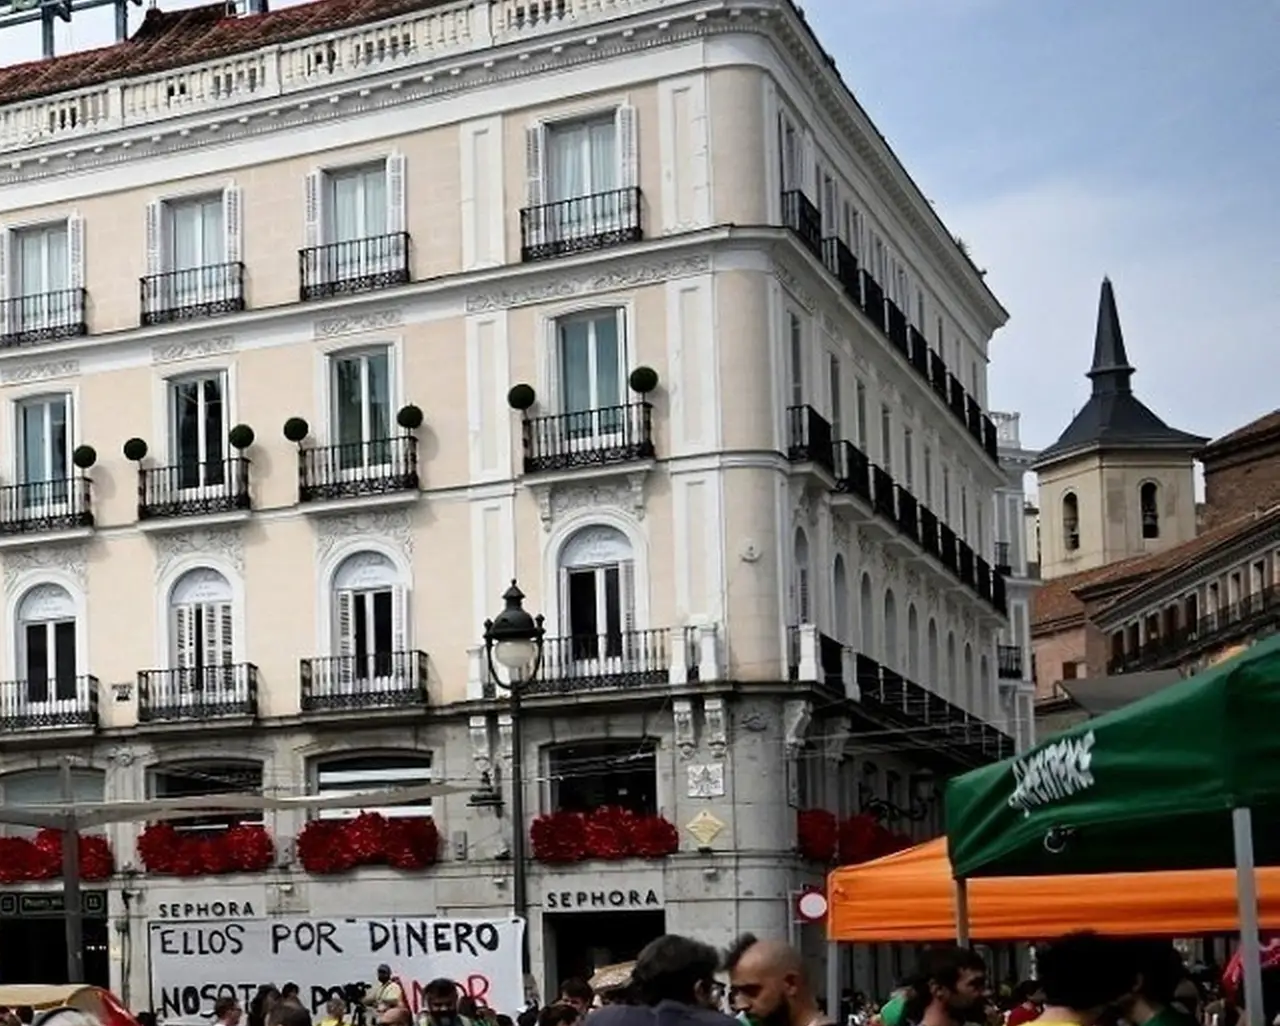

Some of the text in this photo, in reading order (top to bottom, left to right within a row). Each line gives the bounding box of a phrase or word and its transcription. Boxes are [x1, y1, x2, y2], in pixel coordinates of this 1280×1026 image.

[159, 901, 255, 918] SEPHORA
[547, 888, 659, 908] SEPHORA
[160, 918, 498, 957] ELLOS POR DINERO
[161, 983, 276, 1019] NOSOT
